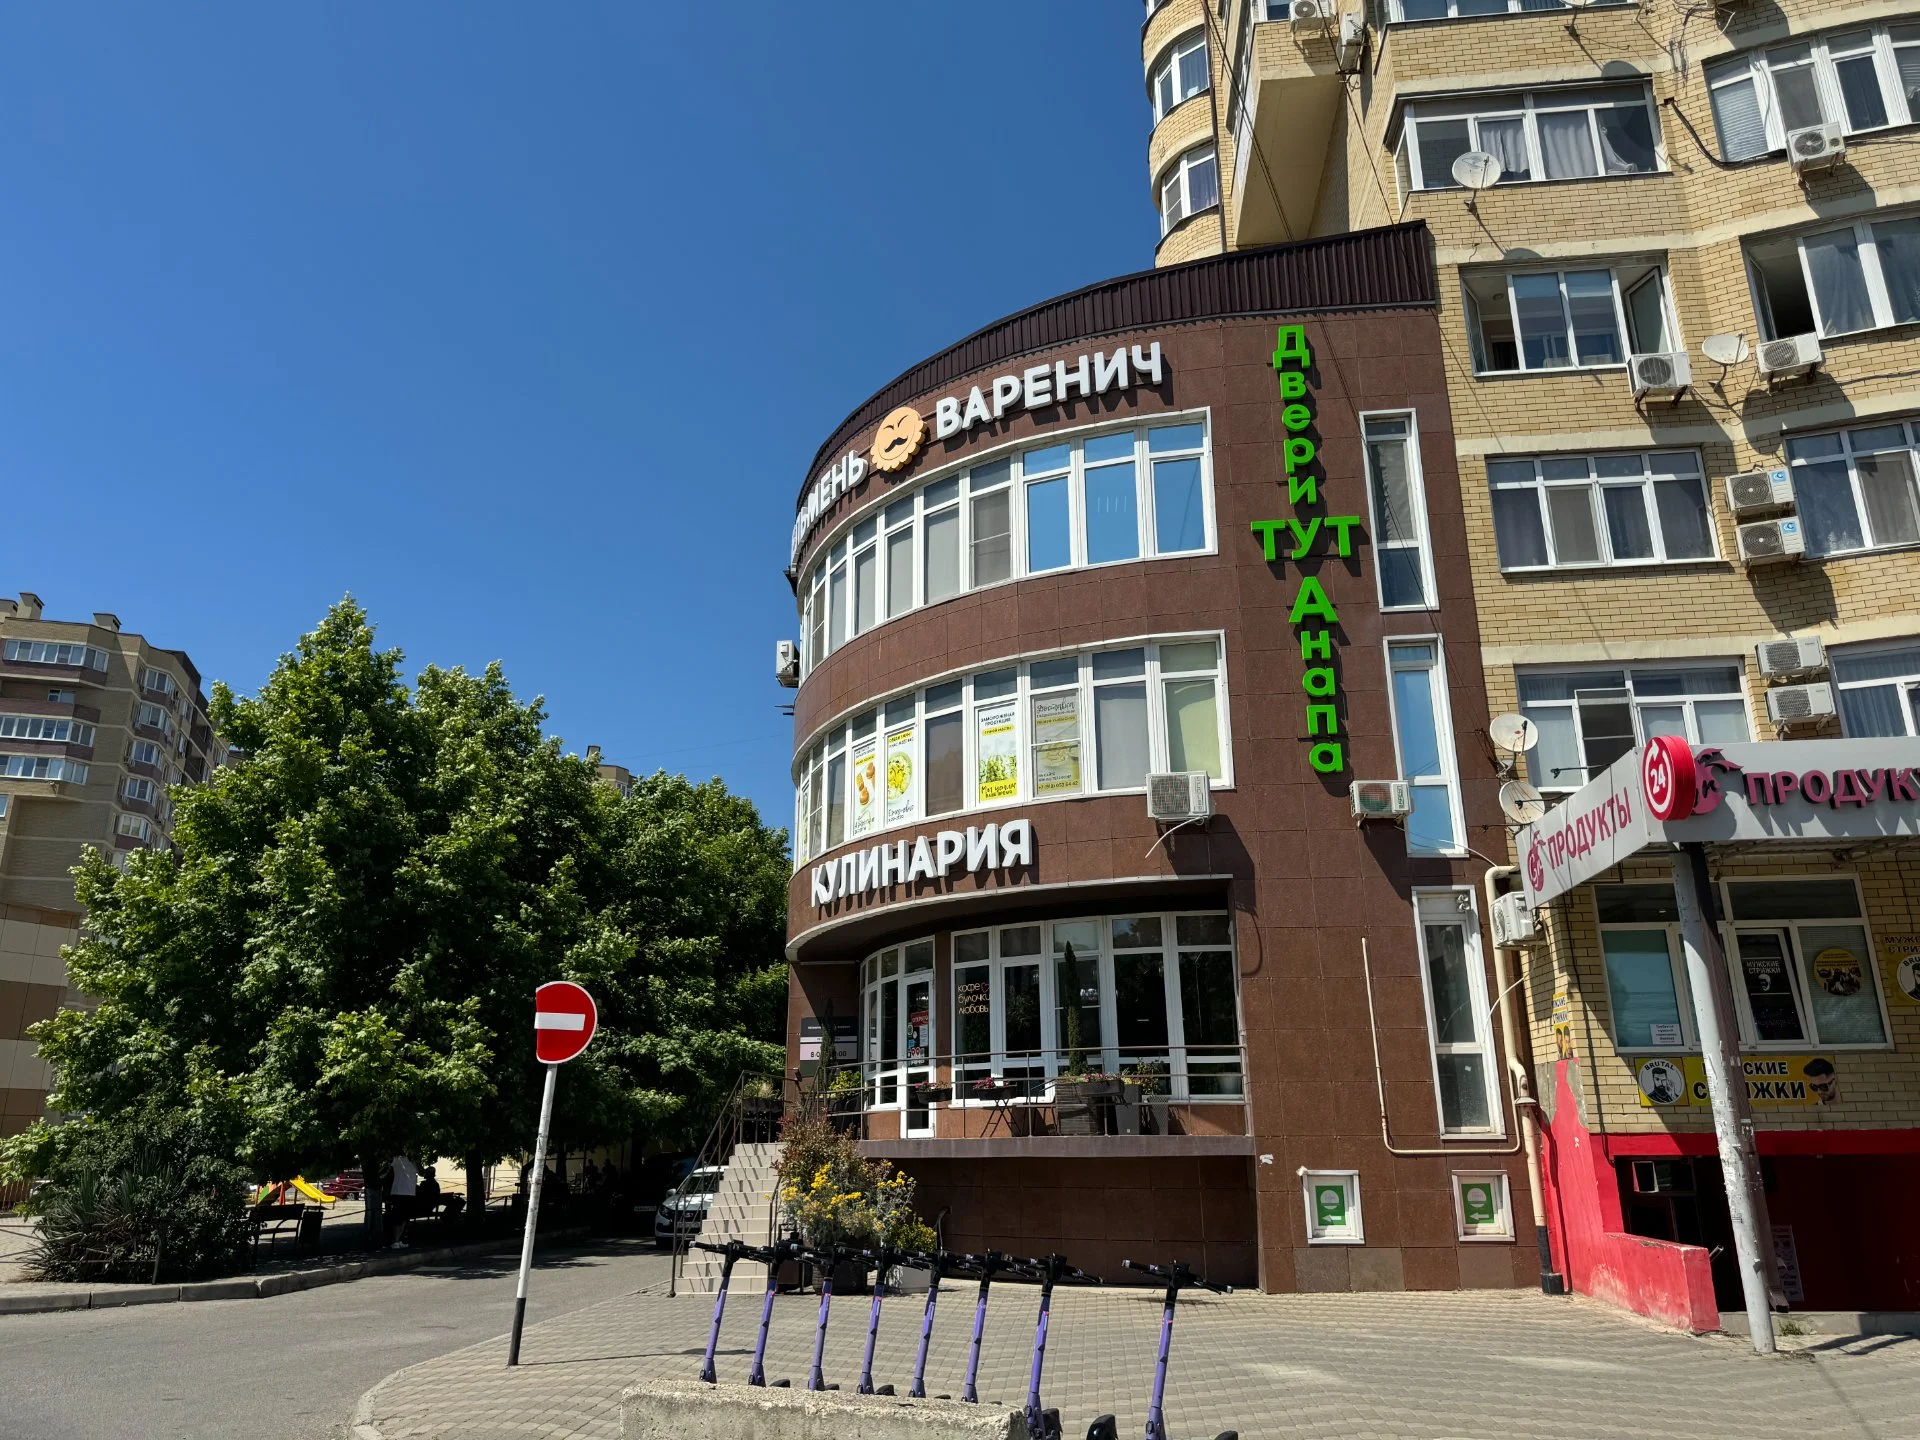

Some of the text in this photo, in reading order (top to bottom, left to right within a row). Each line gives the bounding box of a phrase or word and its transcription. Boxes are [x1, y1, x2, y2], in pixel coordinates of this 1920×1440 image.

[935, 341, 1163, 440] ВАРЕНИЧ
[1272, 324, 1317, 505] Двери
[1288, 576, 1344, 774] Анапа
[1650, 763, 1666, 795] 24
[1743, 767, 1920, 809] ПРОДУК
[1547, 787, 1633, 870] ПРОДУКТЫ
[811, 819, 1032, 907] КУЛИНАРИЯ
[1746, 960, 1780, 968] МУЖСКИЕ
[1748, 967, 1781, 975] СТРИЖКИ
[957, 983, 981, 993] кофе
[958, 1003, 989, 1015] любовь
[1644, 1061, 1675, 1071] BRUTAL
